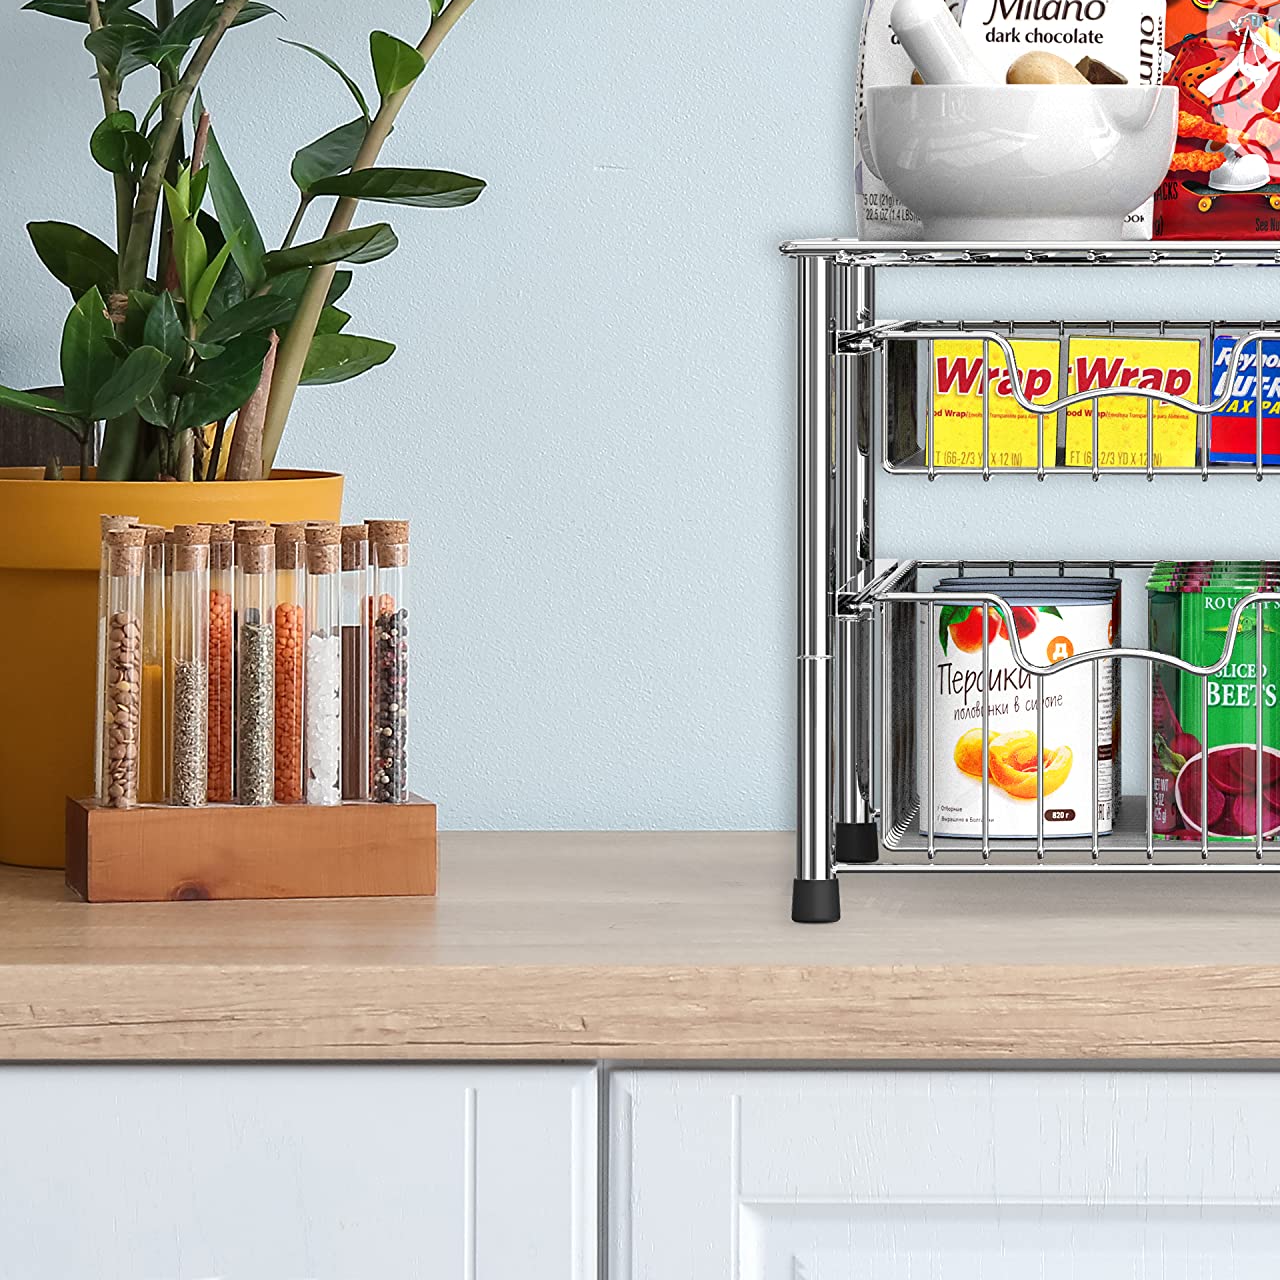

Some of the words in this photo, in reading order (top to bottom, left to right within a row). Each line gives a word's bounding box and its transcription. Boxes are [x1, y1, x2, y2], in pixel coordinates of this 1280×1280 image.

[985, 27, 1021, 44] dark
[1024, 27, 1104, 44] chocolate
[1255, 218, 1268, 232] See
[936, 356, 1052, 402] Wrap
[1076, 356, 1192, 405] Wrap
[1000, 452, 1009, 466] 12
[1070, 451, 1081, 465] FT
[1117, 452, 1129, 465] YD
[1130, 452, 1137, 465] X
[1206, 681, 1277, 707] BEETS
[953, 698, 1009, 721] половнки
[1052, 811, 1065, 819] 820
